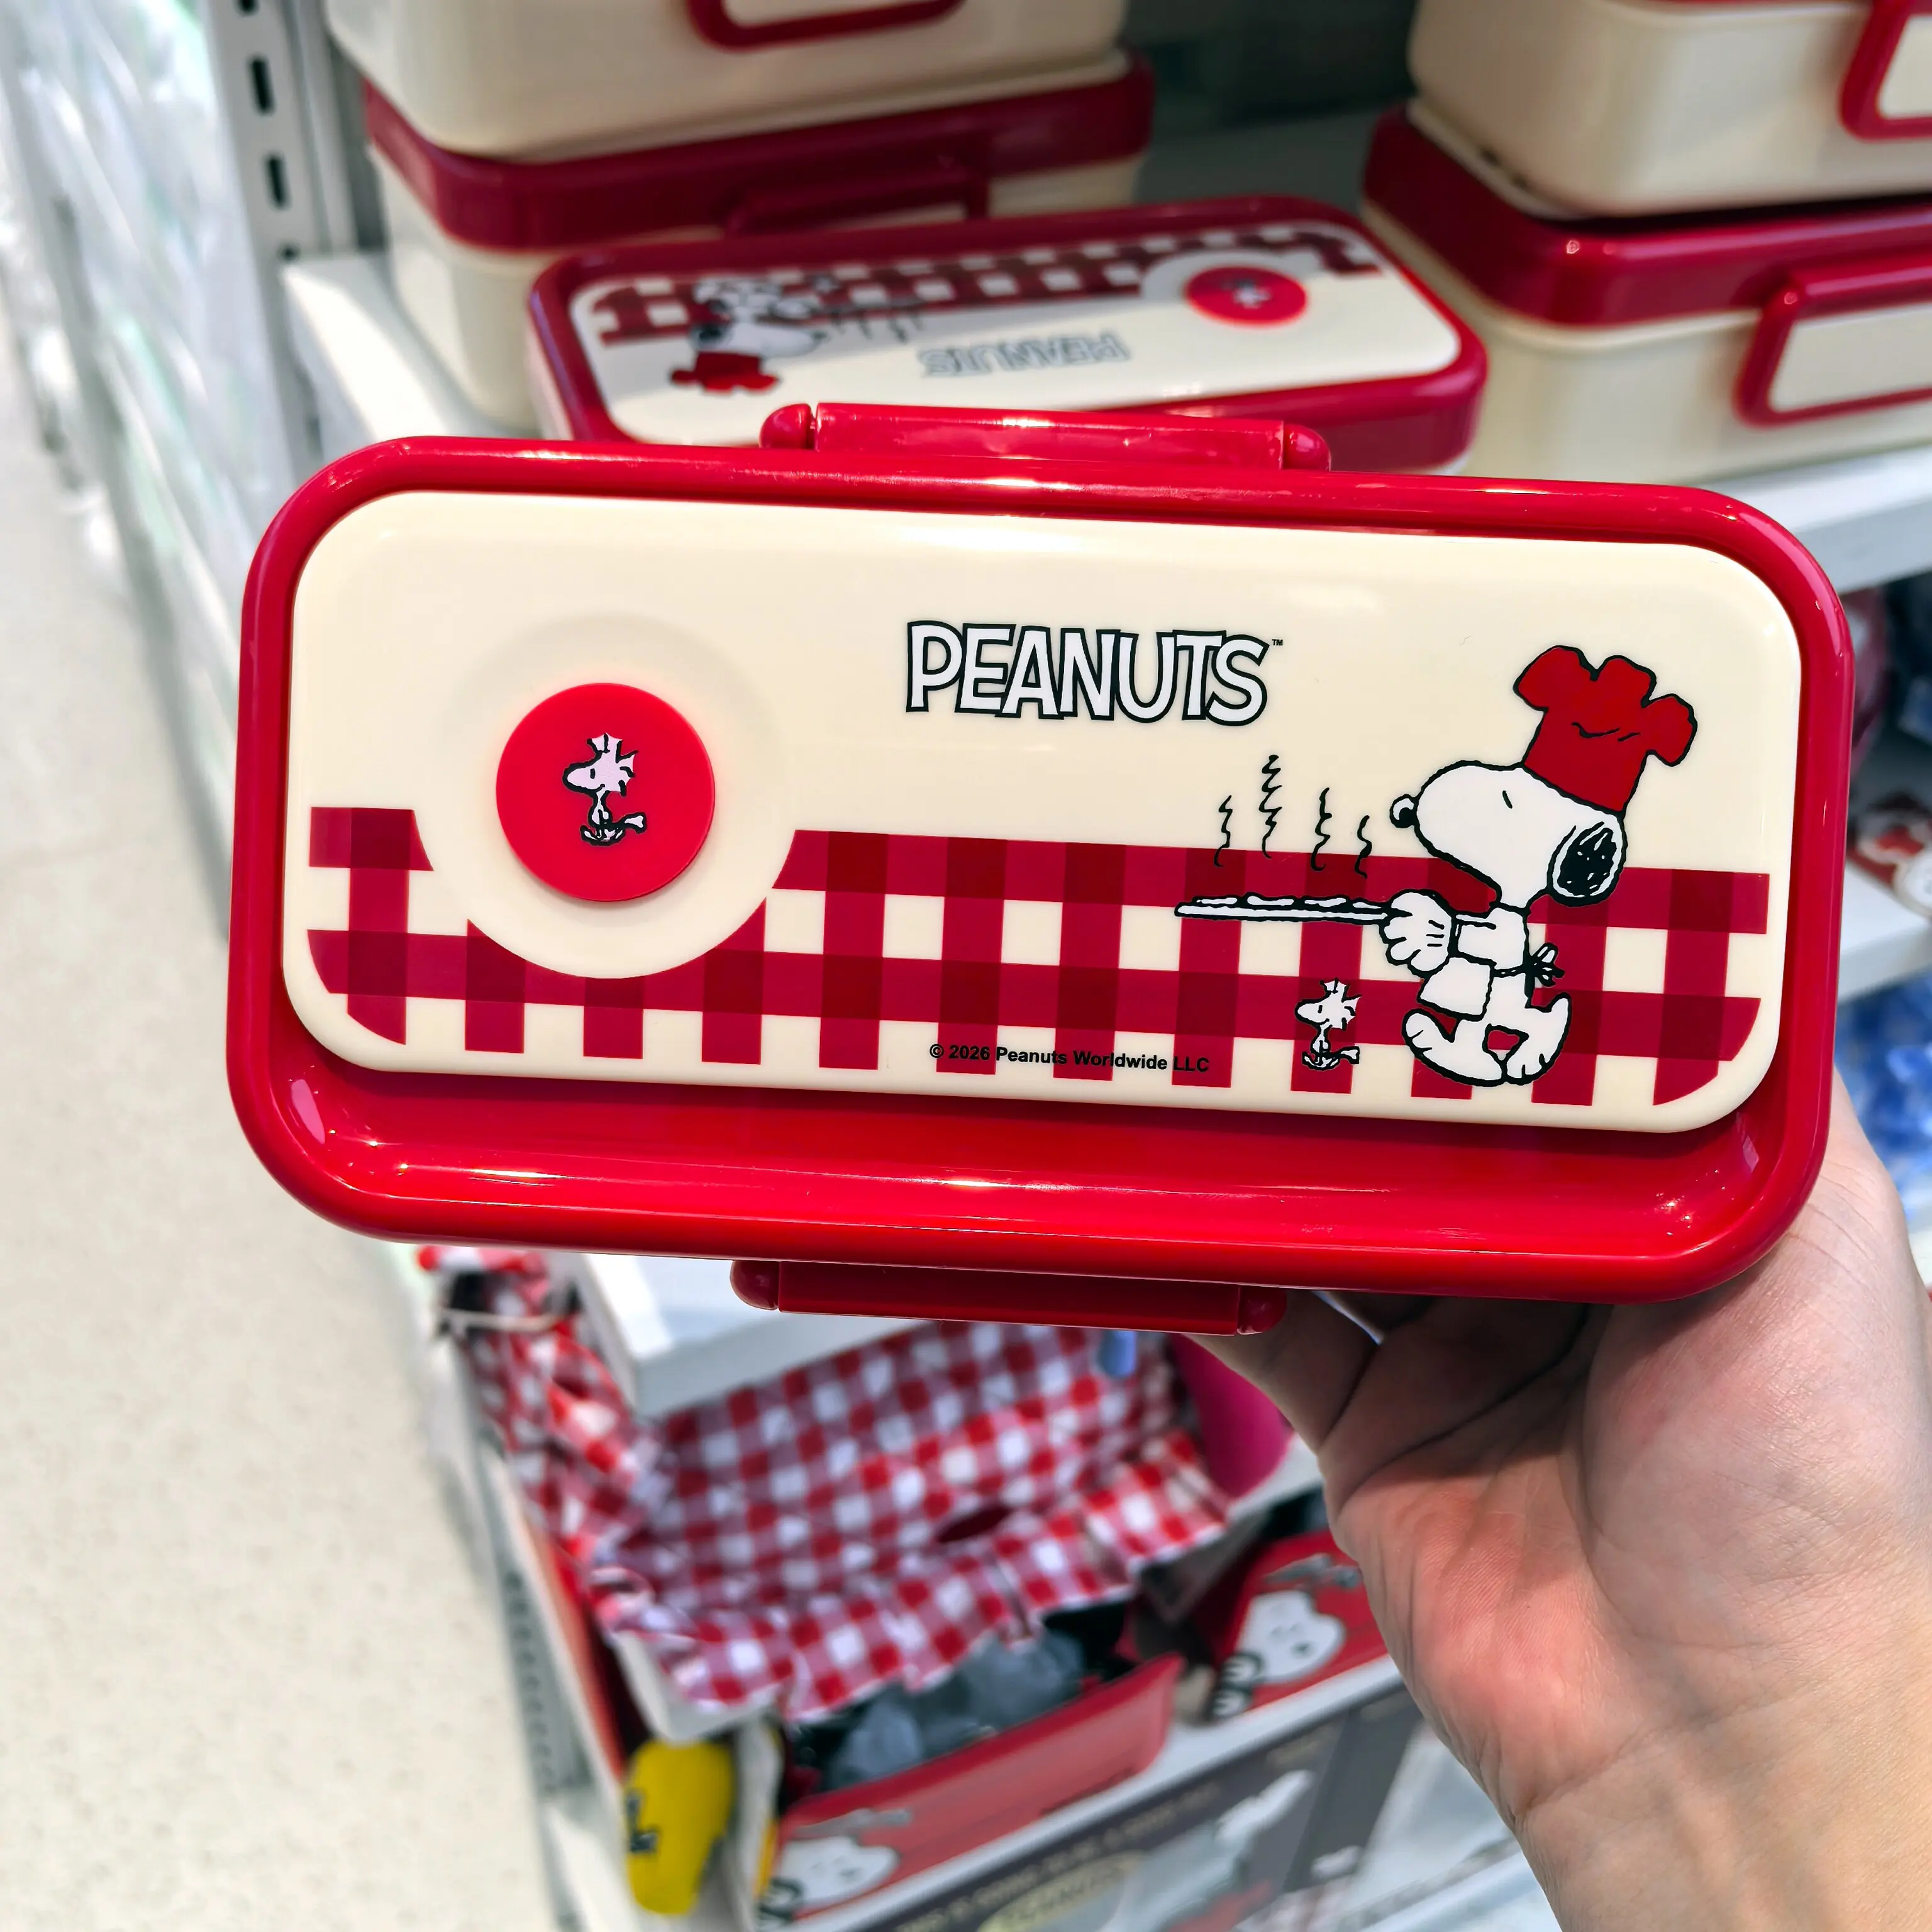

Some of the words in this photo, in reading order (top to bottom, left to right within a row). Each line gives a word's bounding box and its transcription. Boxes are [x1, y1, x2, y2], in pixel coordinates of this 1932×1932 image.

[916, 329, 1132, 377] PEANUTS
[906, 620, 1270, 726] PEANUTS
[948, 1045, 991, 1060] 2026
[996, 1046, 1067, 1065] Peanuts
[1073, 1050, 1168, 1070] Worldwide
[1173, 1057, 1210, 1073] LLC
